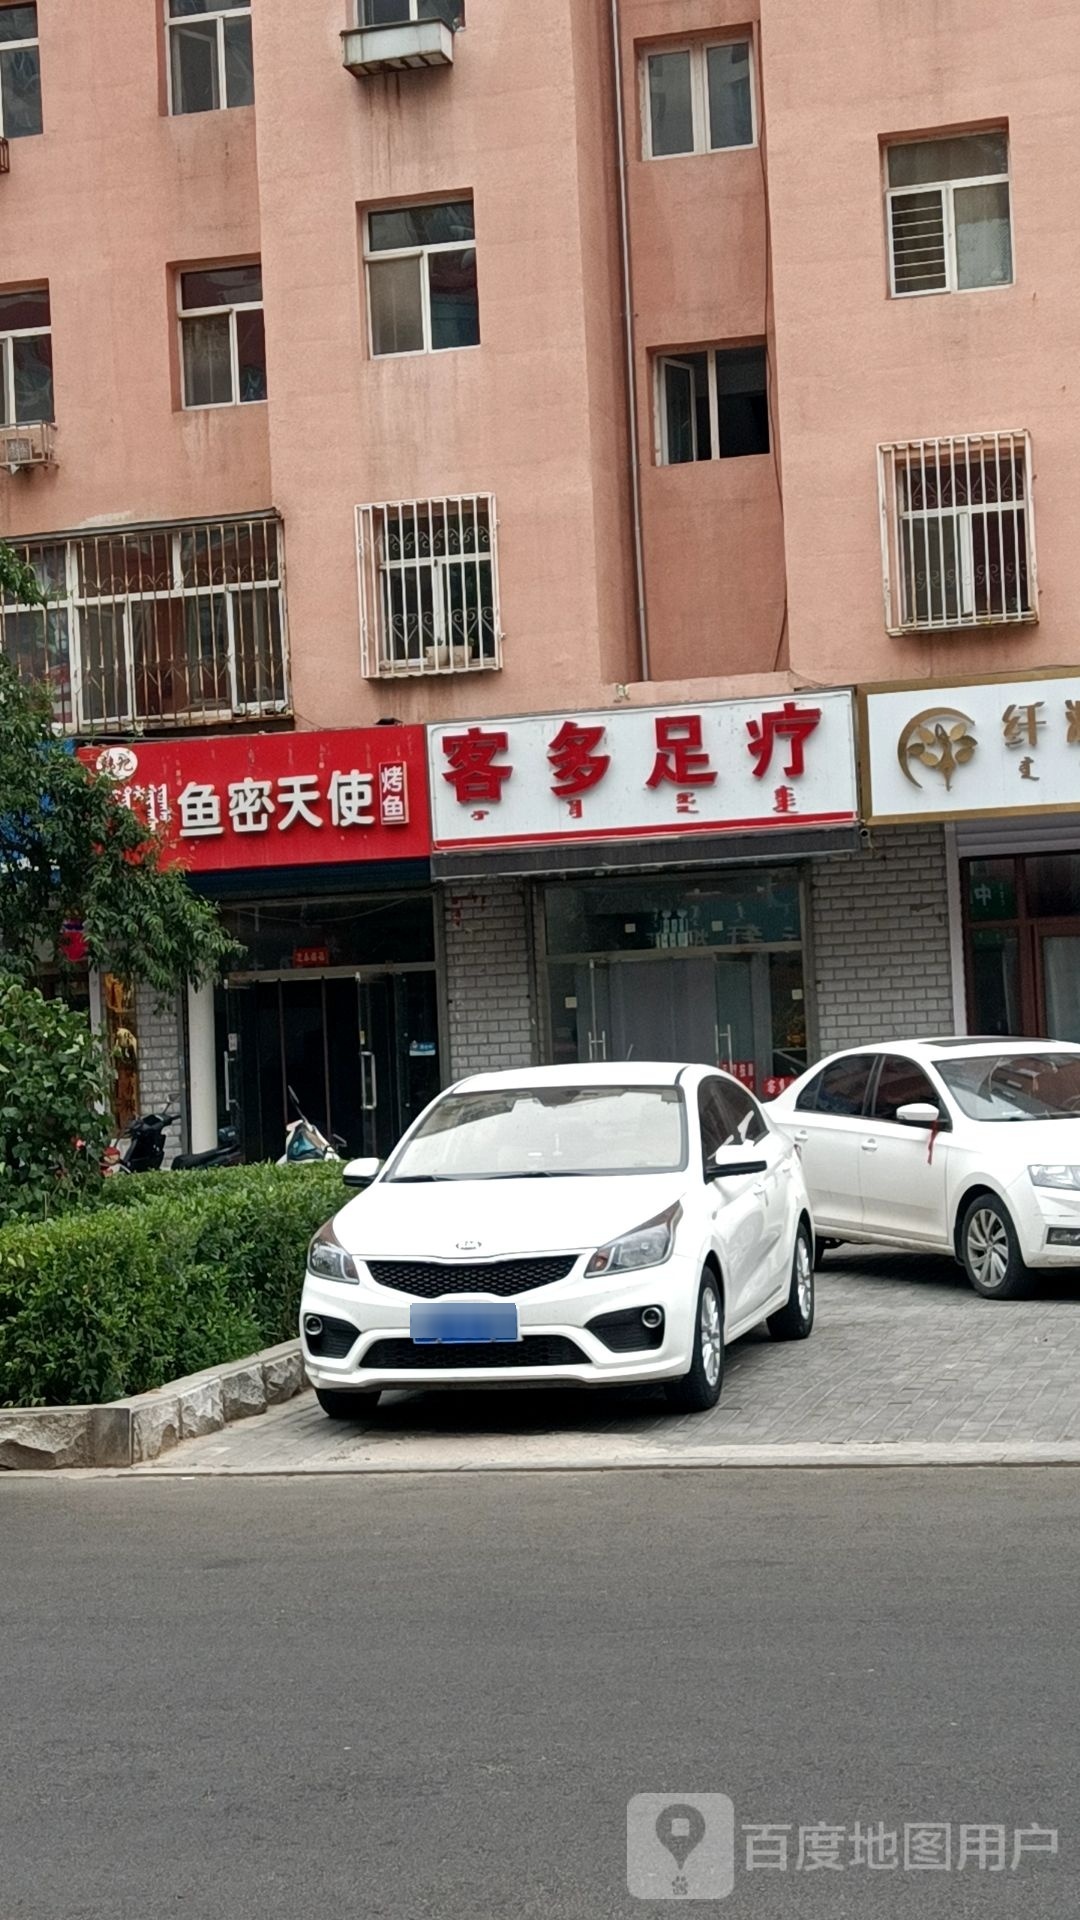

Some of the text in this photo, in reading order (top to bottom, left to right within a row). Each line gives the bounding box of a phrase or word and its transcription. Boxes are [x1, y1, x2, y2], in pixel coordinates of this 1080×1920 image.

[441, 701, 822, 807] 客多足疗
[176, 768, 375, 838] 鱼密天使
[381, 765, 405, 821] 烤鱼
